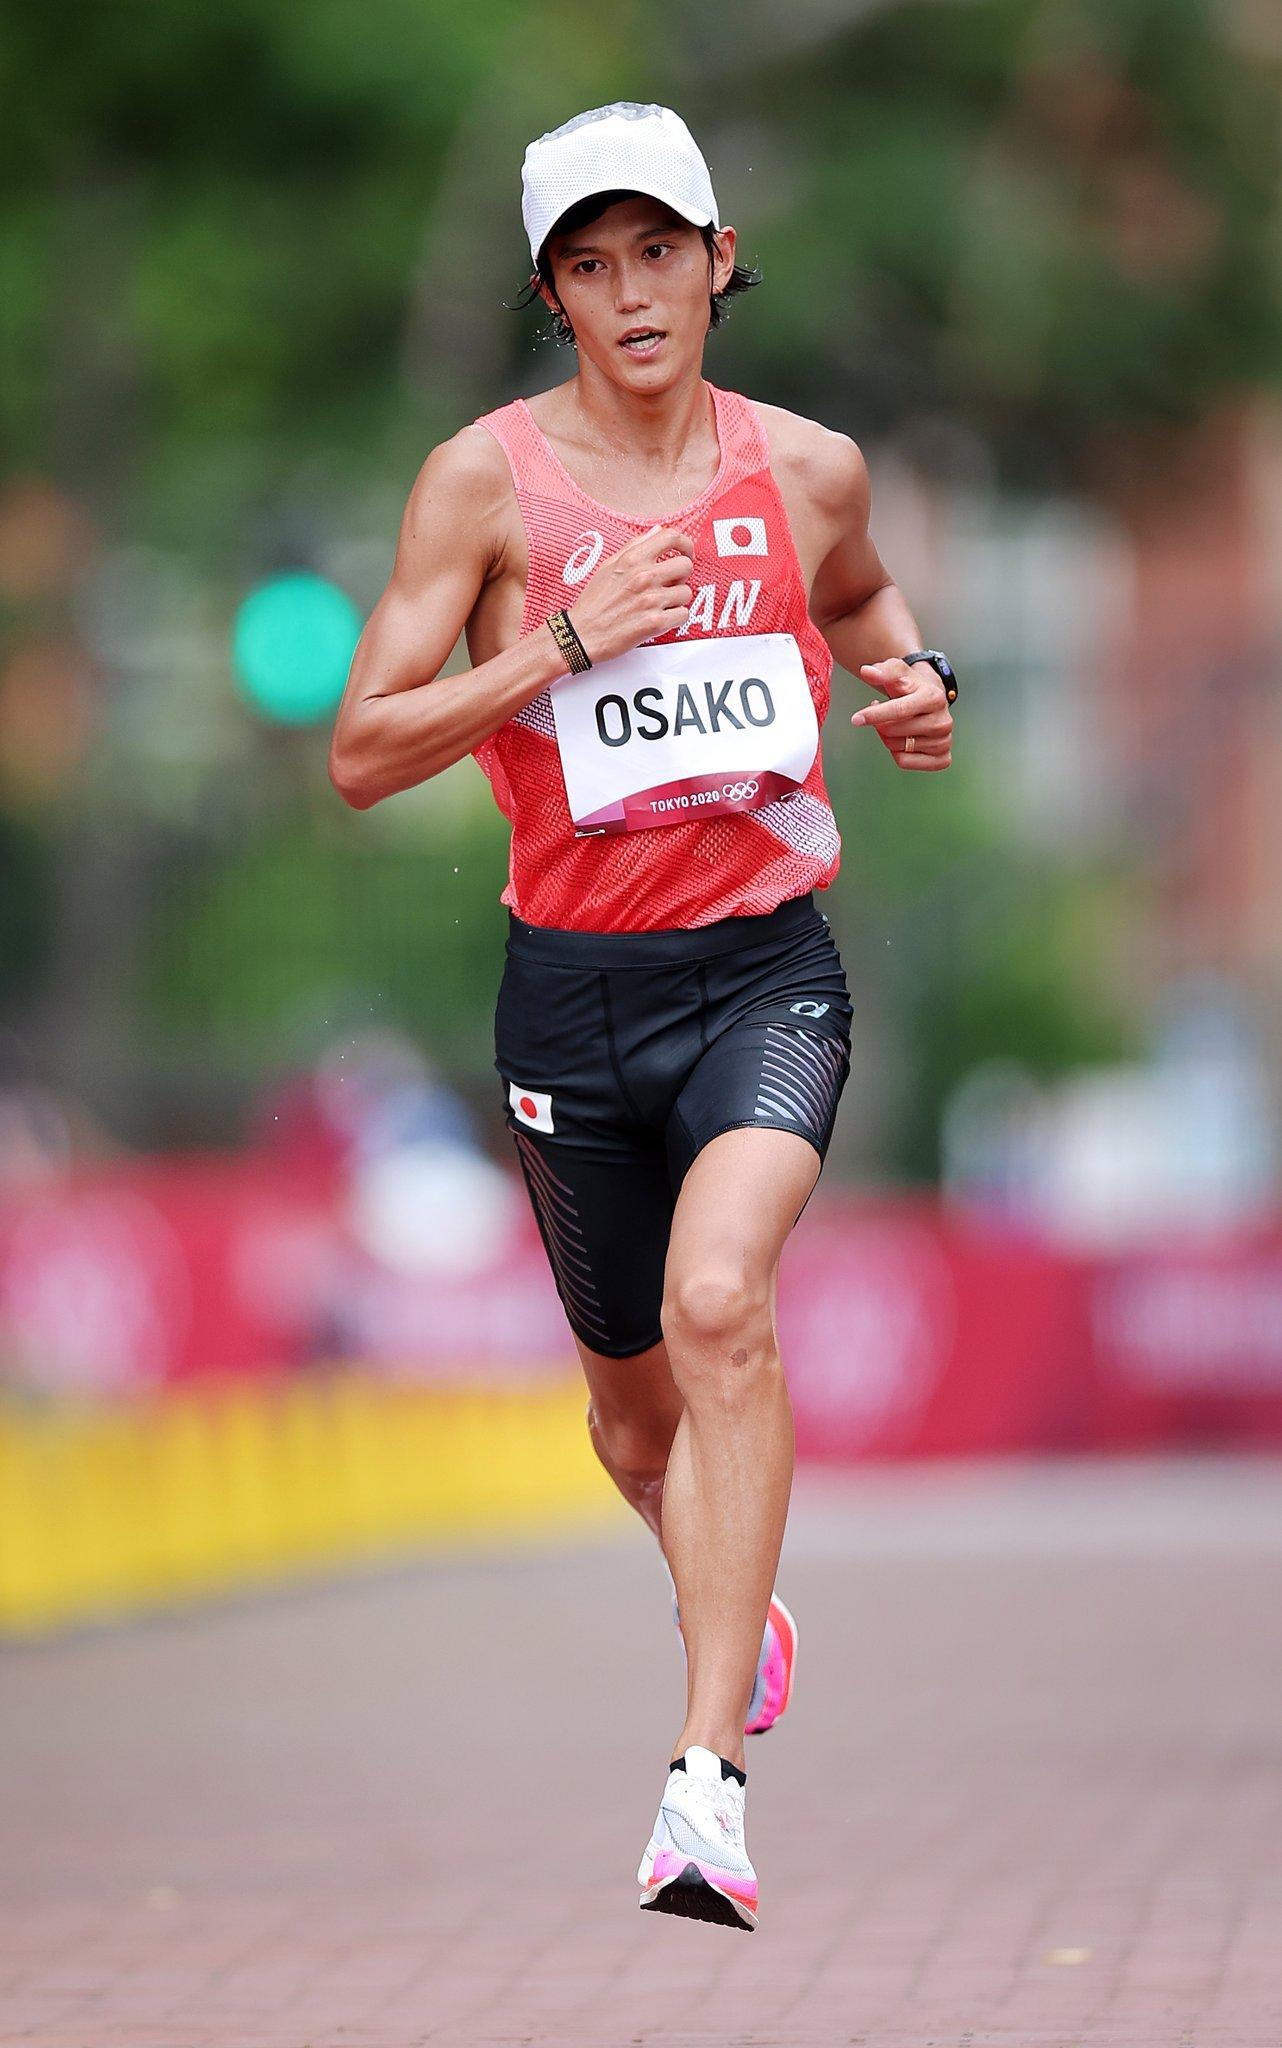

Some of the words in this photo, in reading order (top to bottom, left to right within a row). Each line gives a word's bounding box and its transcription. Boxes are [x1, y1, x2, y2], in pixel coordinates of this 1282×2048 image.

[594, 677, 776, 747] OSAKO
[650, 795, 689, 813] TOKYO
[691, 790, 720, 806] 2020
